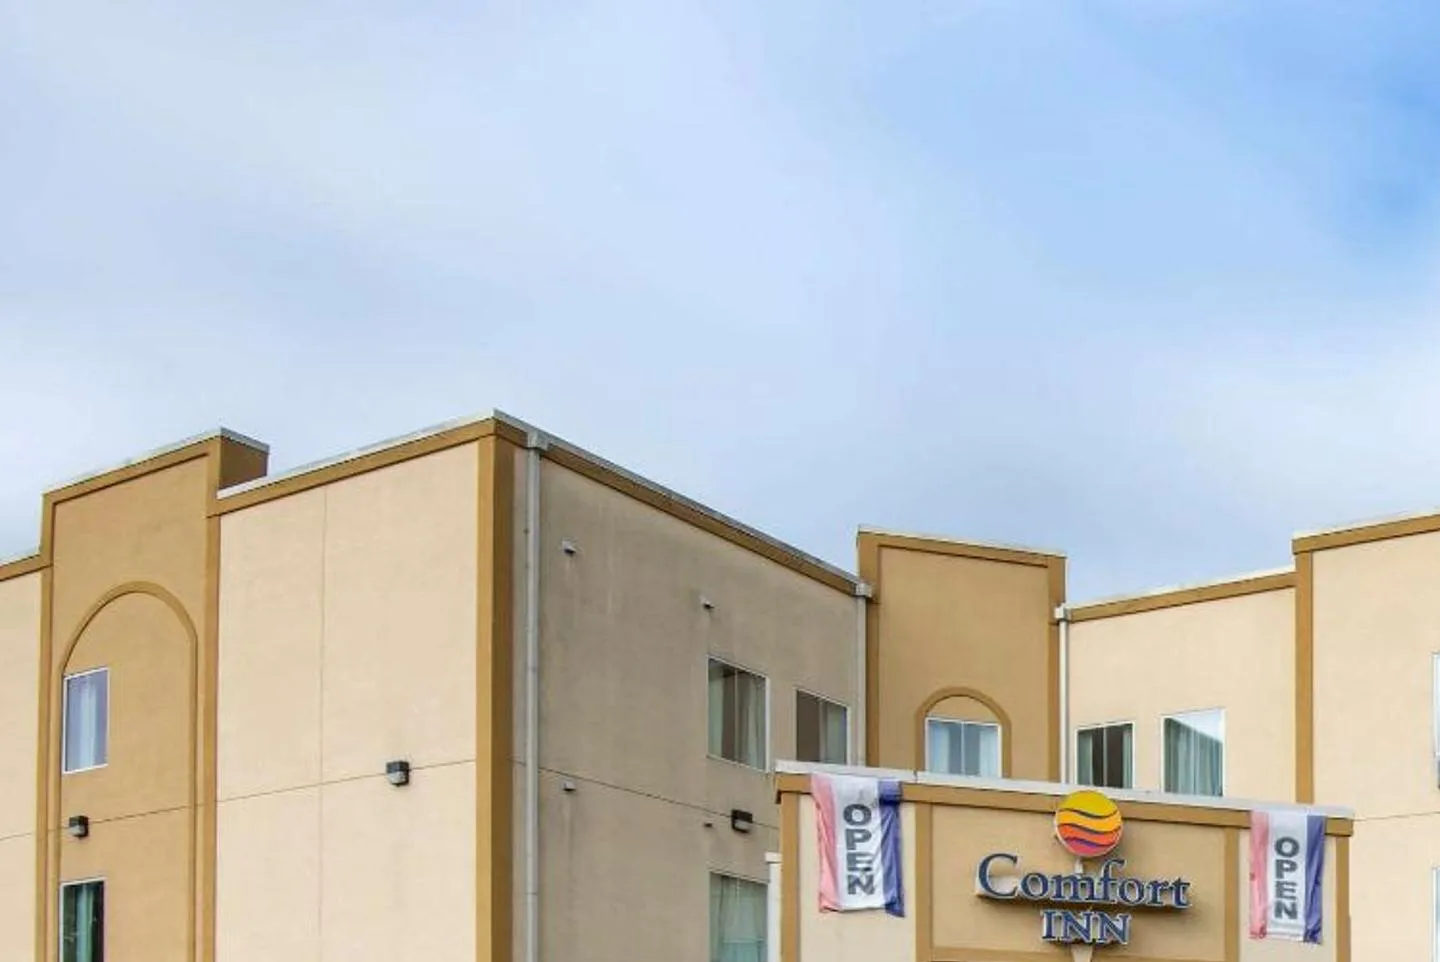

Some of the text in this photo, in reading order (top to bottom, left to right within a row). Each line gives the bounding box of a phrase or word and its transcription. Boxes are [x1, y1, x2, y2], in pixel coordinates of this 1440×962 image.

[843, 804, 875, 895] OPEN
[976, 852, 1192, 908] Comfort
[1275, 836, 1300, 920] OPEN
[1041, 909, 1131, 943] INN
